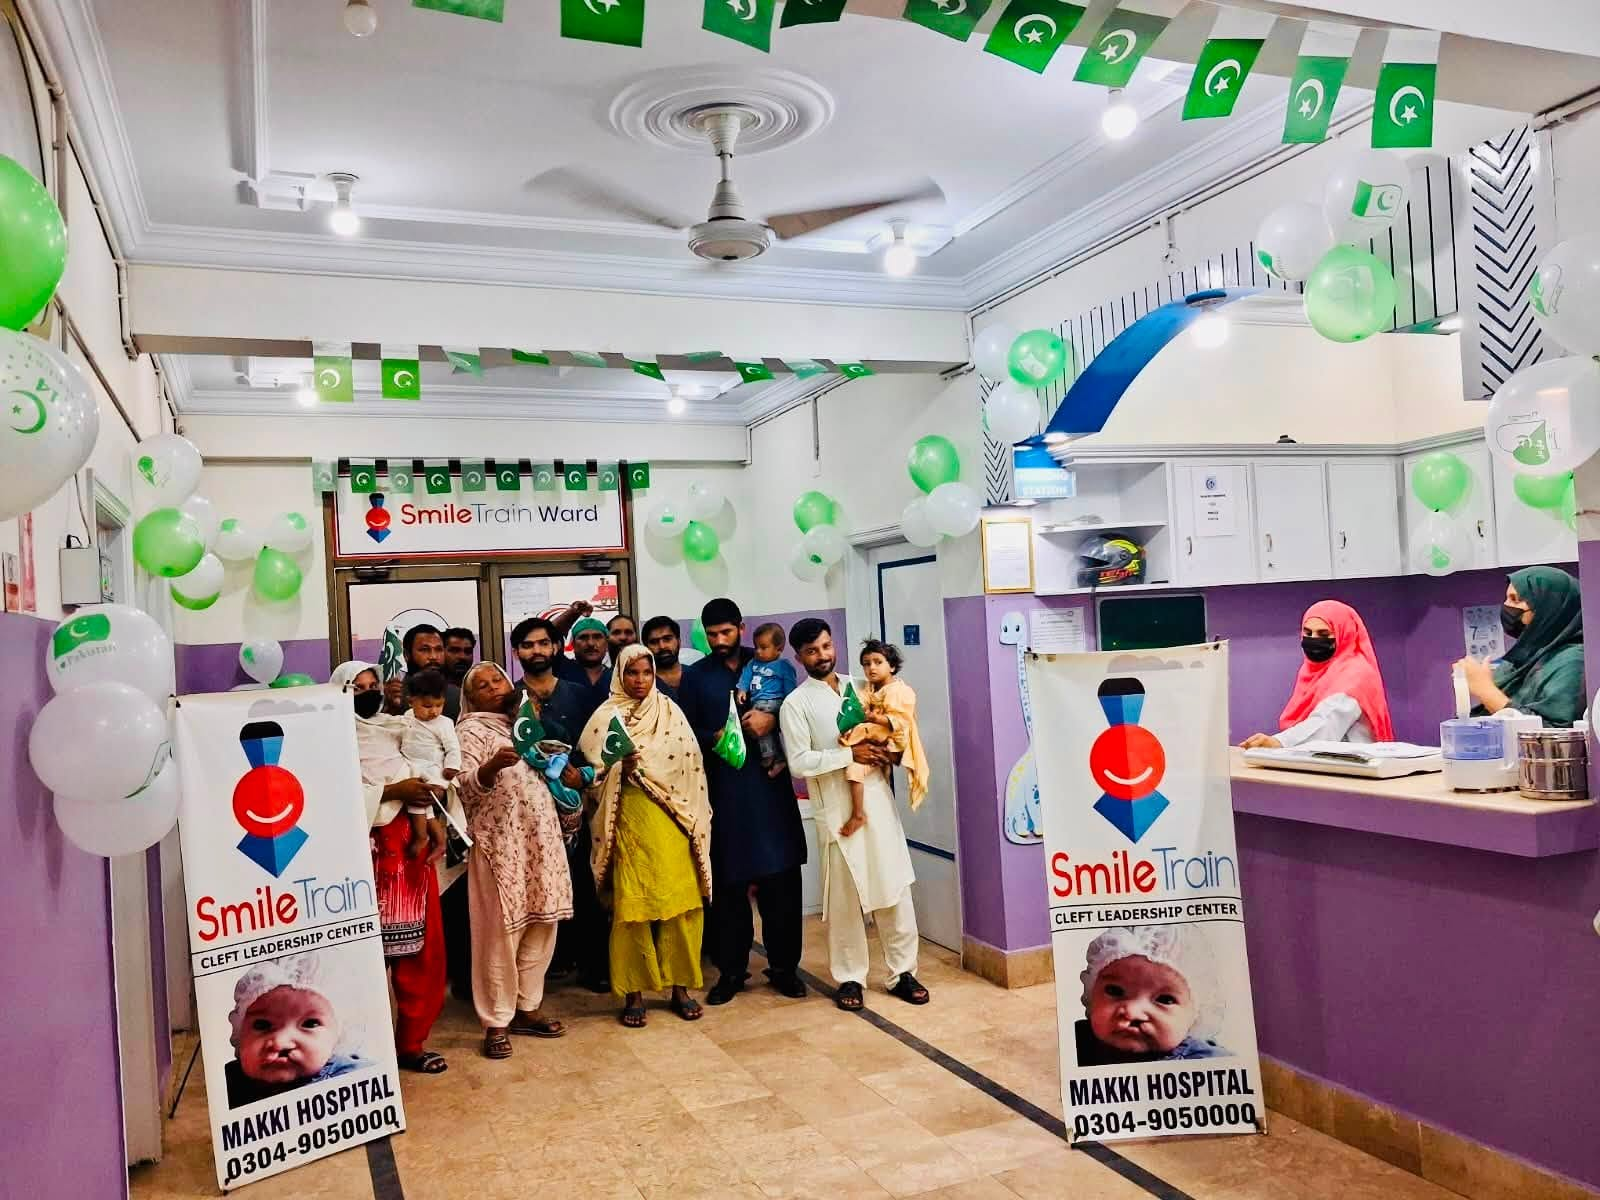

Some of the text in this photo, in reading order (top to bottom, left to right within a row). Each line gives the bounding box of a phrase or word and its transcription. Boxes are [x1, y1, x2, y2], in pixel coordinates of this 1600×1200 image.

[538, 504, 598, 523] Ward
[1055, 903, 1238, 925] CLEFT LEADERSHIP CENTER
[200, 921, 375, 969] CLEFT LEADERSHIP CENTER
[1069, 1069, 1254, 1106] MAKKI HOSPITAL
[221, 1074, 394, 1151] MAKKI HOSPITAL
[1074, 1103, 1256, 1138] 0304-9050000
[225, 1105, 398, 1181] 0304-9050000
